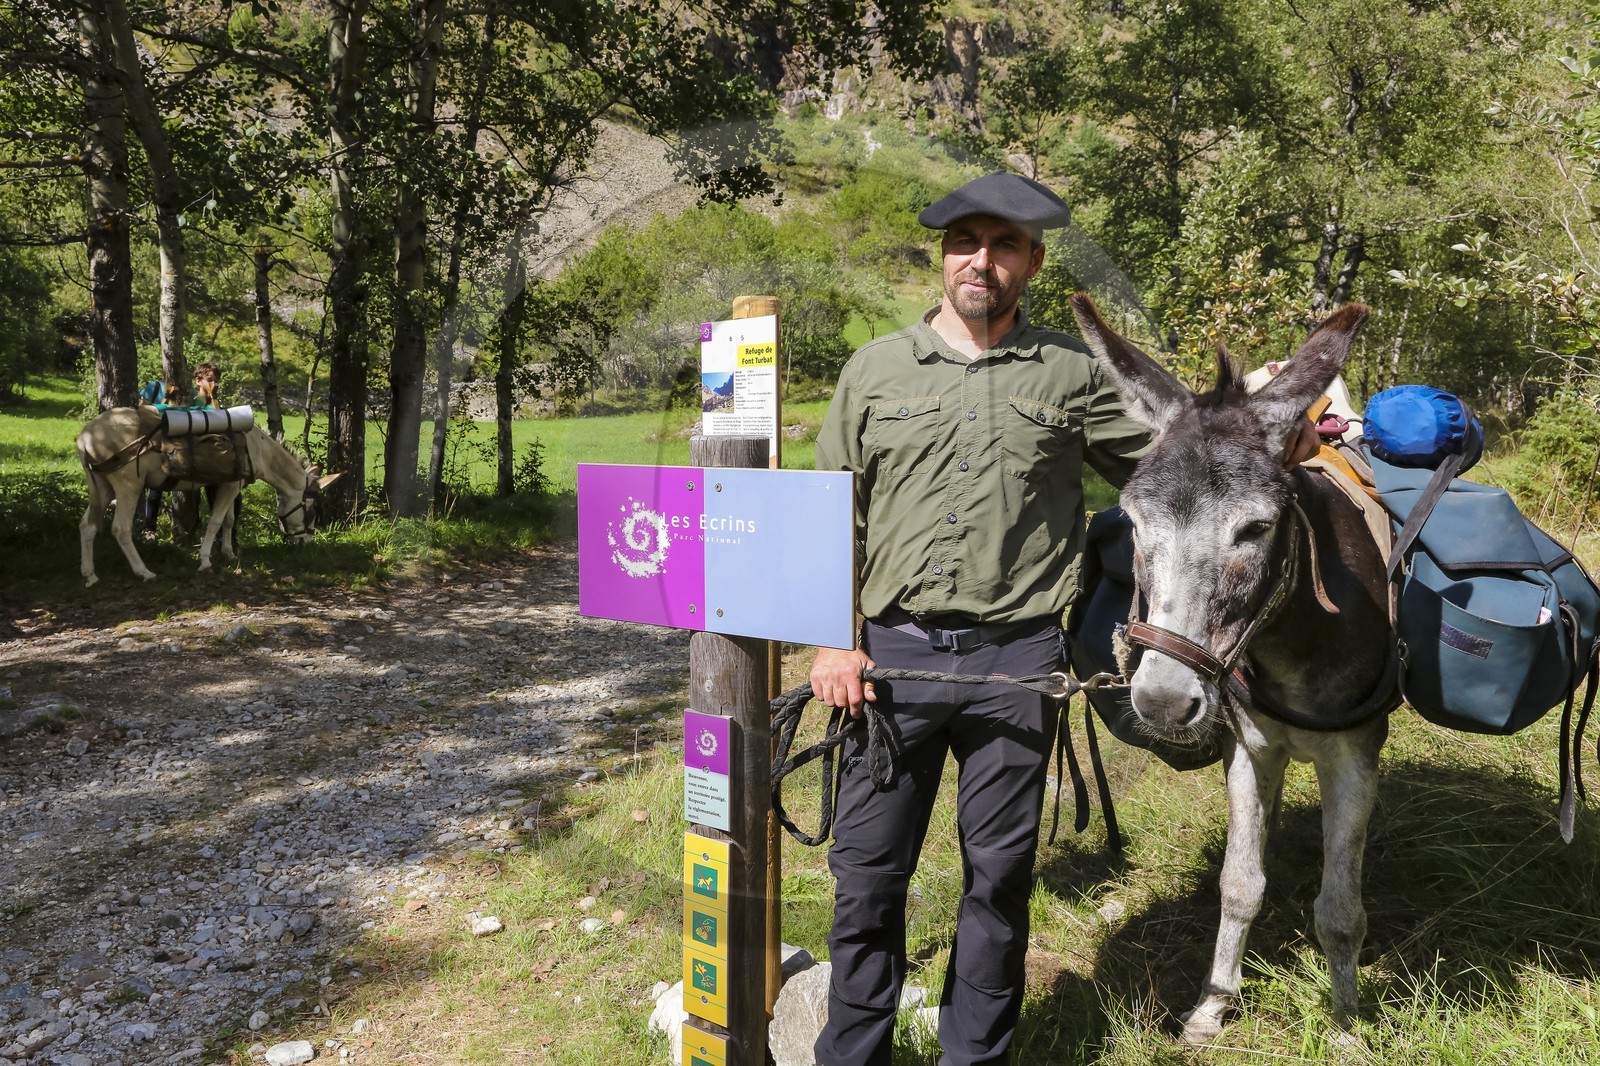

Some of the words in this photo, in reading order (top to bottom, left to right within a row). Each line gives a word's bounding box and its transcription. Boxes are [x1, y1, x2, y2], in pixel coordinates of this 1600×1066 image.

[745, 347, 764, 356] Refuge
[741, 357, 754, 365] Font
[755, 356, 773, 364] Turbat
[661, 511, 690, 528] Les
[699, 513, 756, 533] Ecrins
[673, 533, 693, 541] Parc
[698, 534, 741, 544] National
